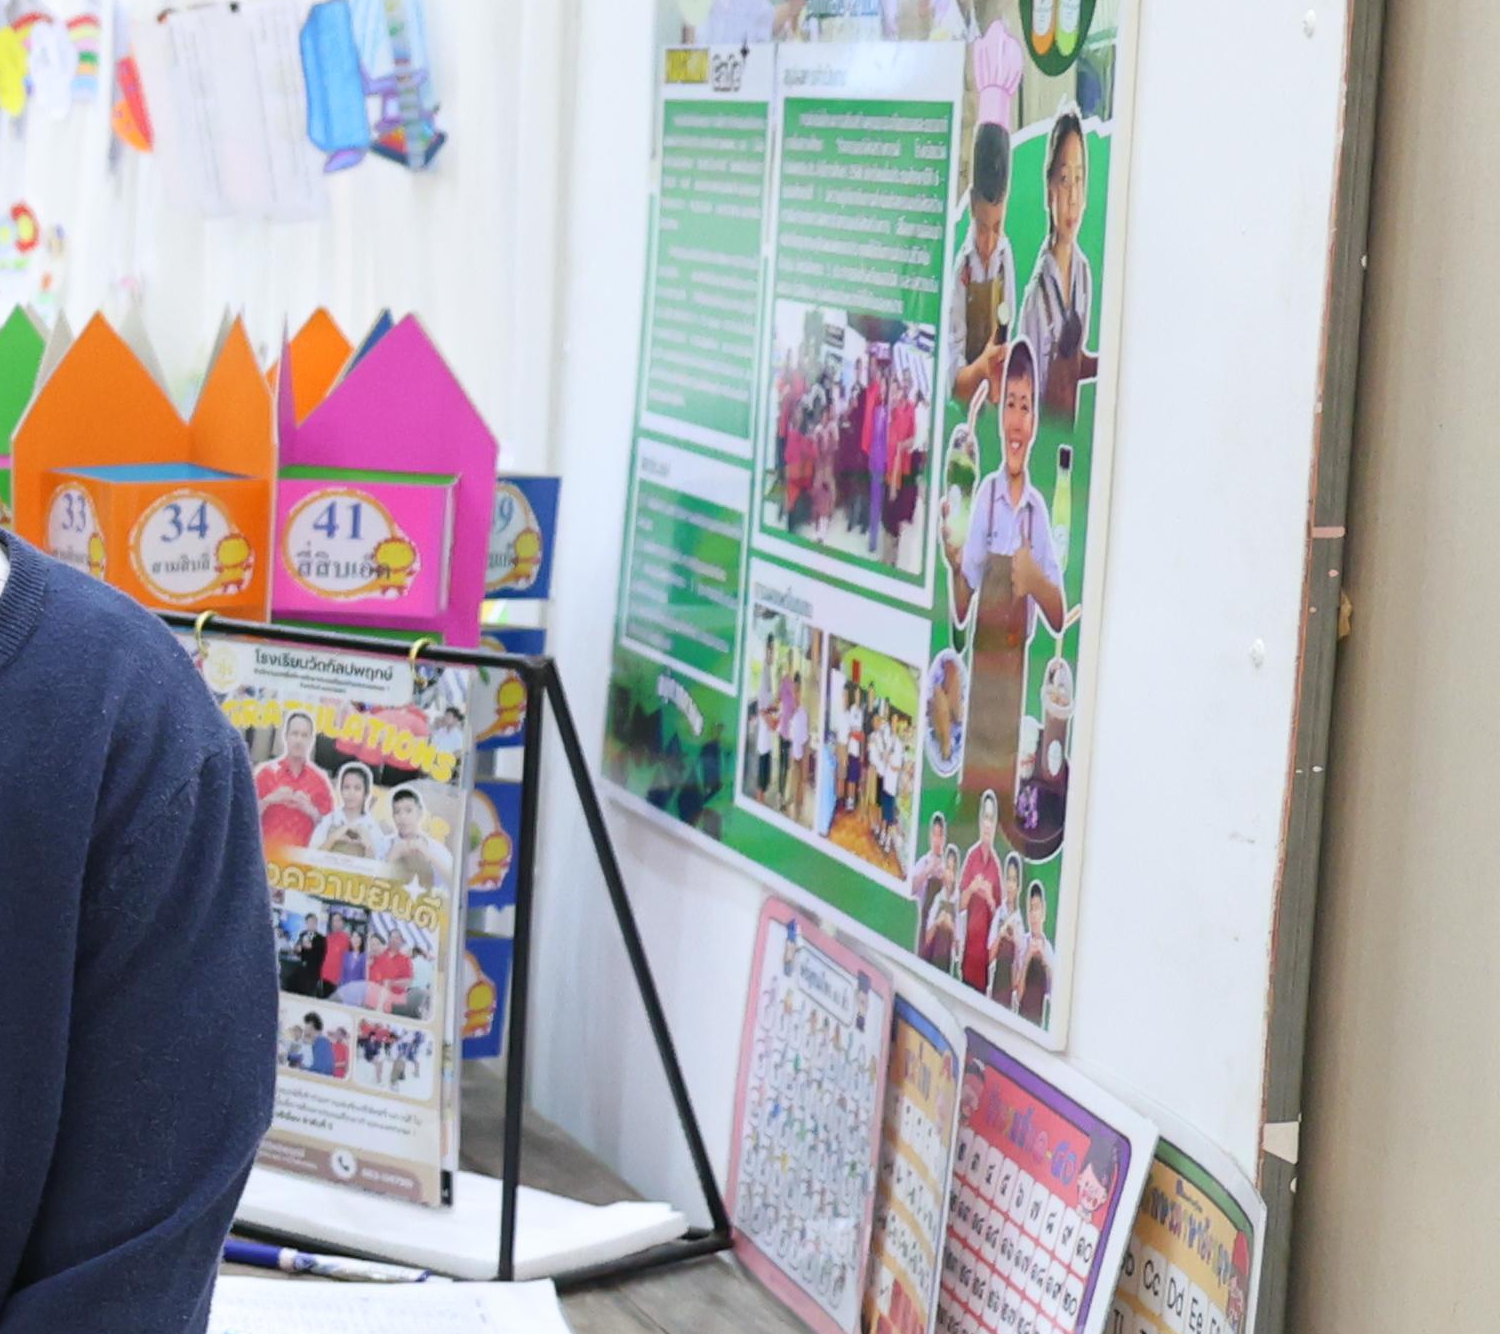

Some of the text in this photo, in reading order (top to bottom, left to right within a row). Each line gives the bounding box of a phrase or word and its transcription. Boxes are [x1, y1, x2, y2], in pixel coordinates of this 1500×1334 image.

[62, 493, 87, 533] 33
[161, 501, 210, 543] 34
[313, 501, 365, 540] 41
[255, 648, 394, 682] โรงเรียนวัดกัลปพฤกษ์
[1143, 1259, 1161, 1297] Cc
[1167, 1278, 1184, 1317] Dd
